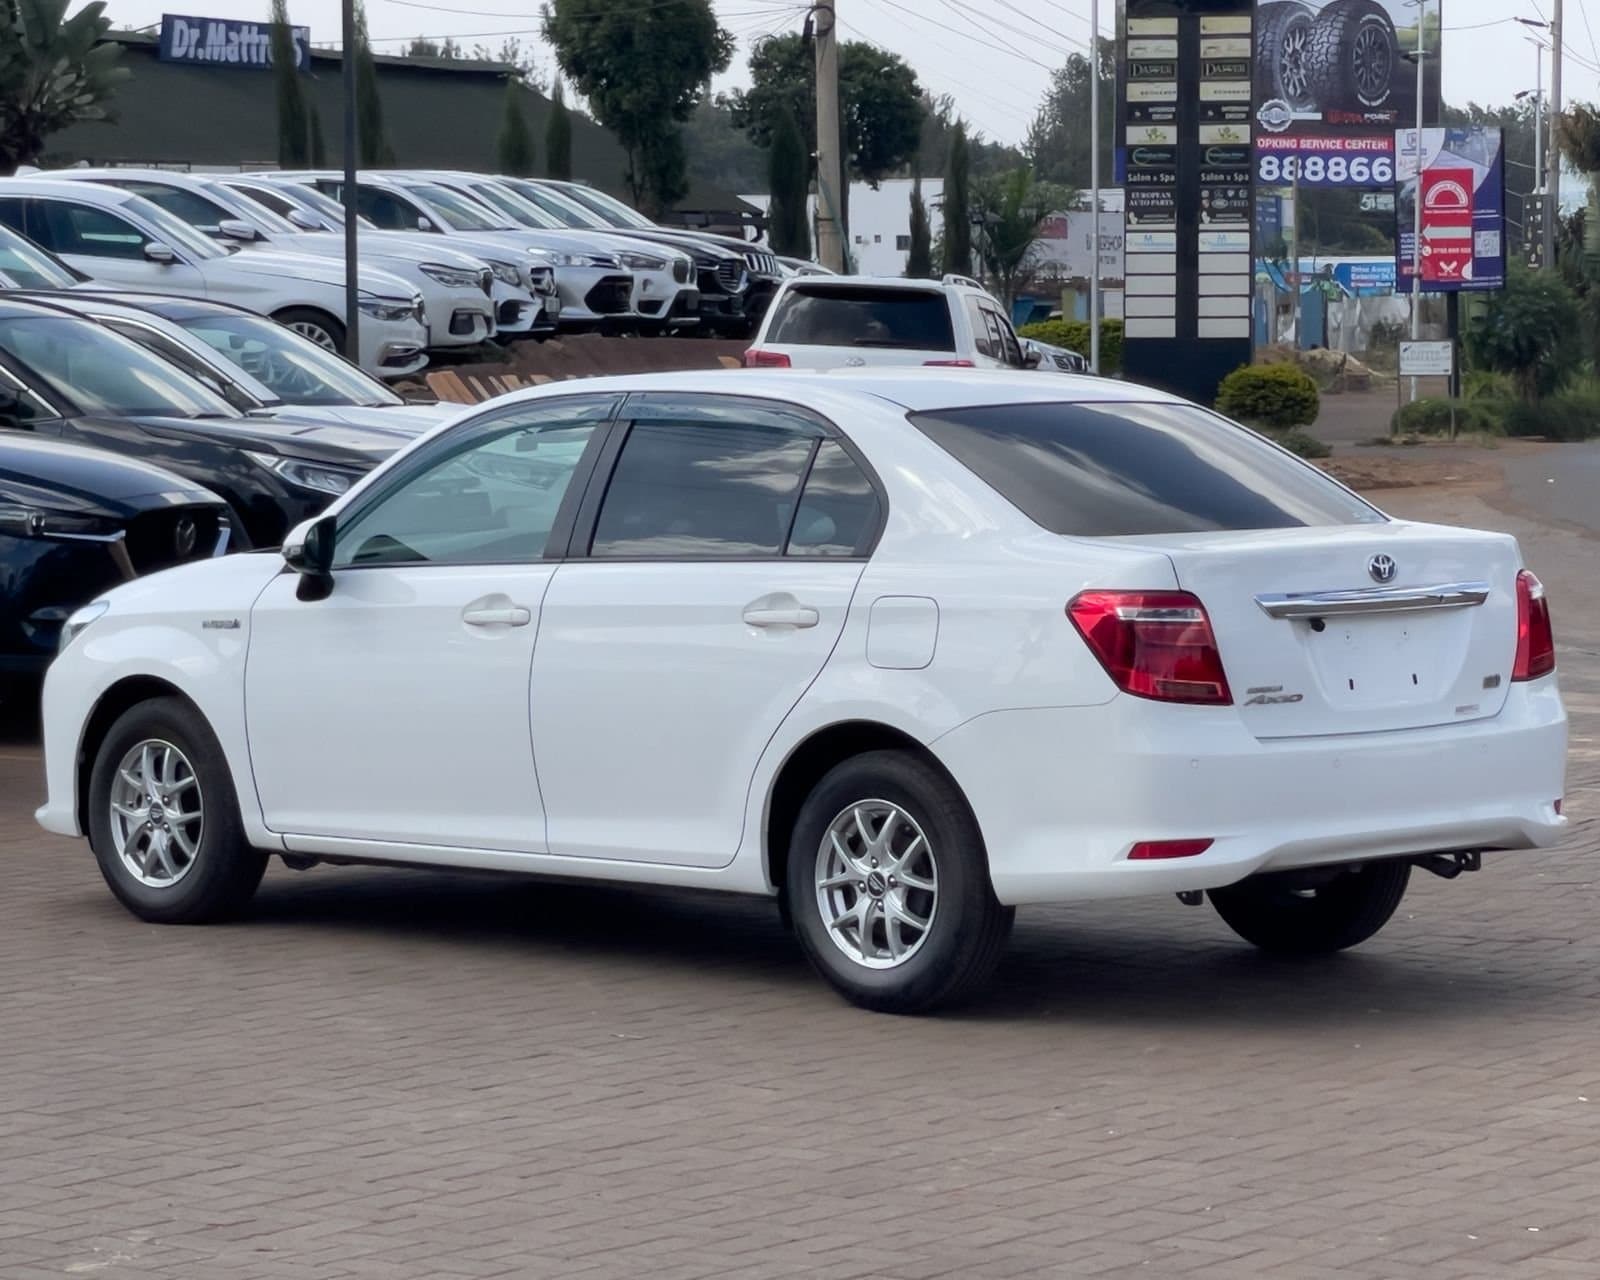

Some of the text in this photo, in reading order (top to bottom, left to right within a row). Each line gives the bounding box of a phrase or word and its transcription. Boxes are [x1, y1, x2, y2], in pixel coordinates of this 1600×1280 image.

[1300, 140, 1343, 150] SERVICE
[1260, 156, 1392, 182] 888866
[1128, 173, 1152, 182] Salon
[1160, 173, 1175, 183] Spa
[1201, 172, 1225, 181] Salon
[1234, 172, 1249, 182] Spa
